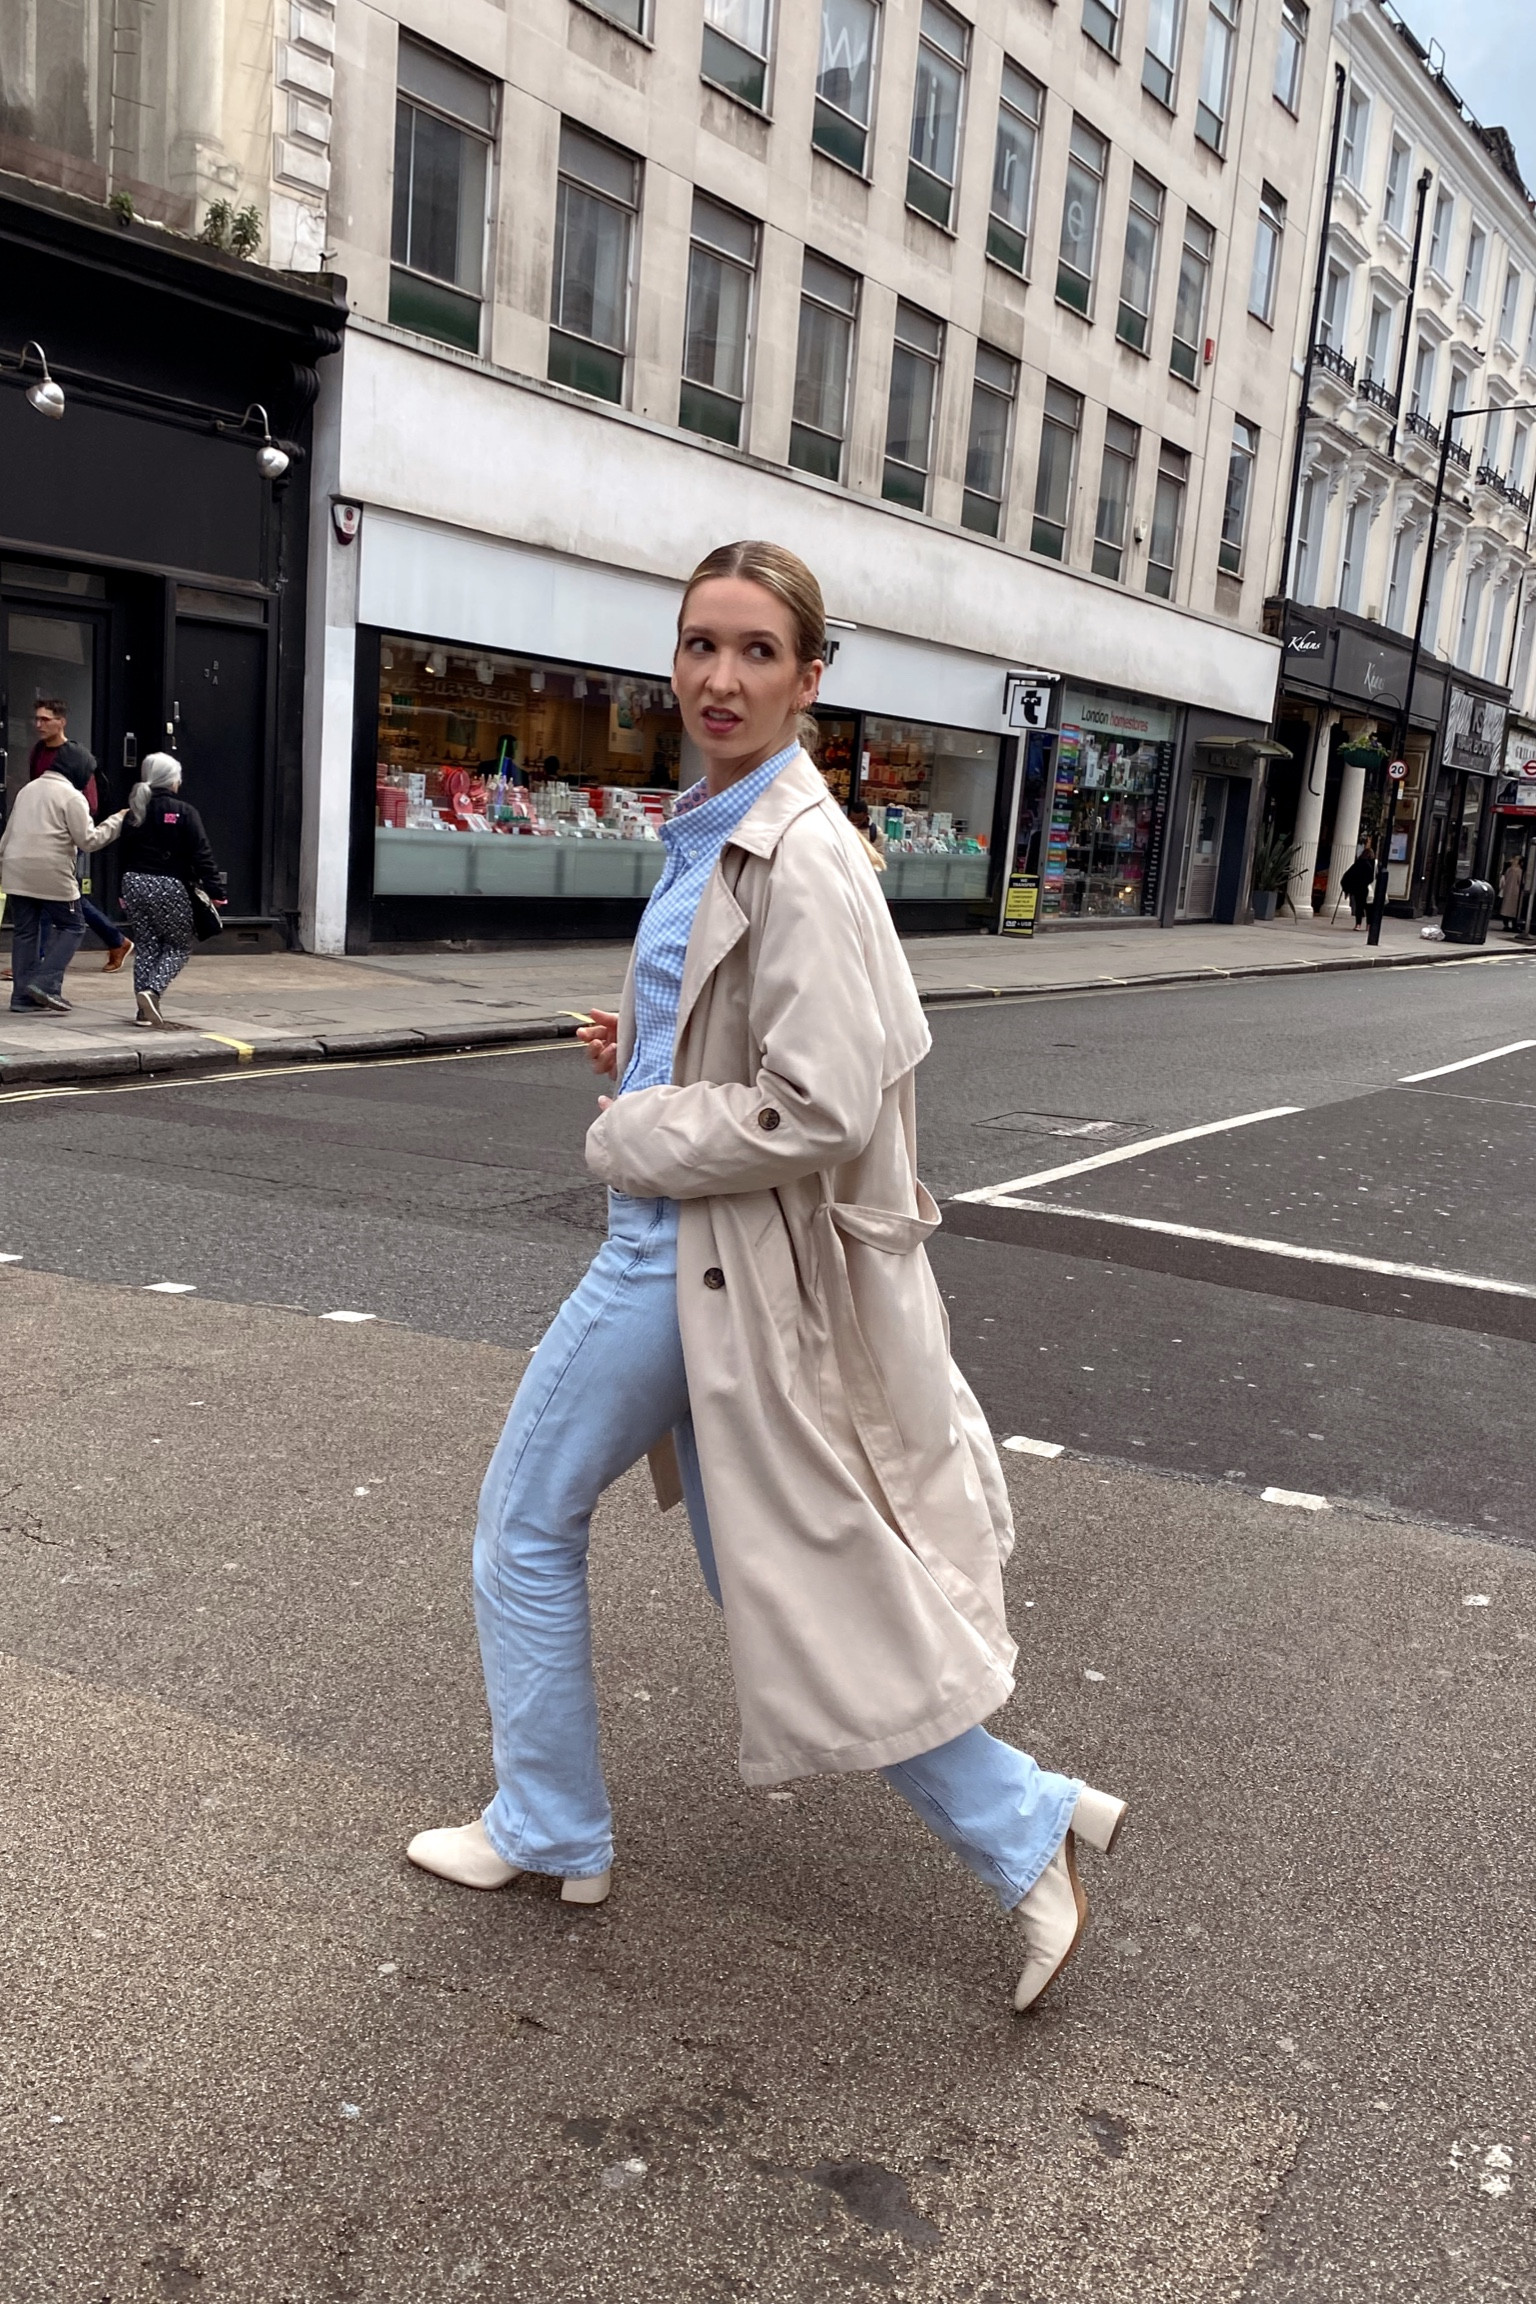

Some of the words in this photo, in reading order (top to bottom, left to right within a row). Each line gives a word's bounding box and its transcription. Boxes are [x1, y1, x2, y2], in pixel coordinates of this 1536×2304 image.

[1288, 630, 1322, 652] Khans
[1081, 705, 1109, 724] London
[1110, 710, 1149, 732] homestores
[1391, 765, 1404, 775] 20
